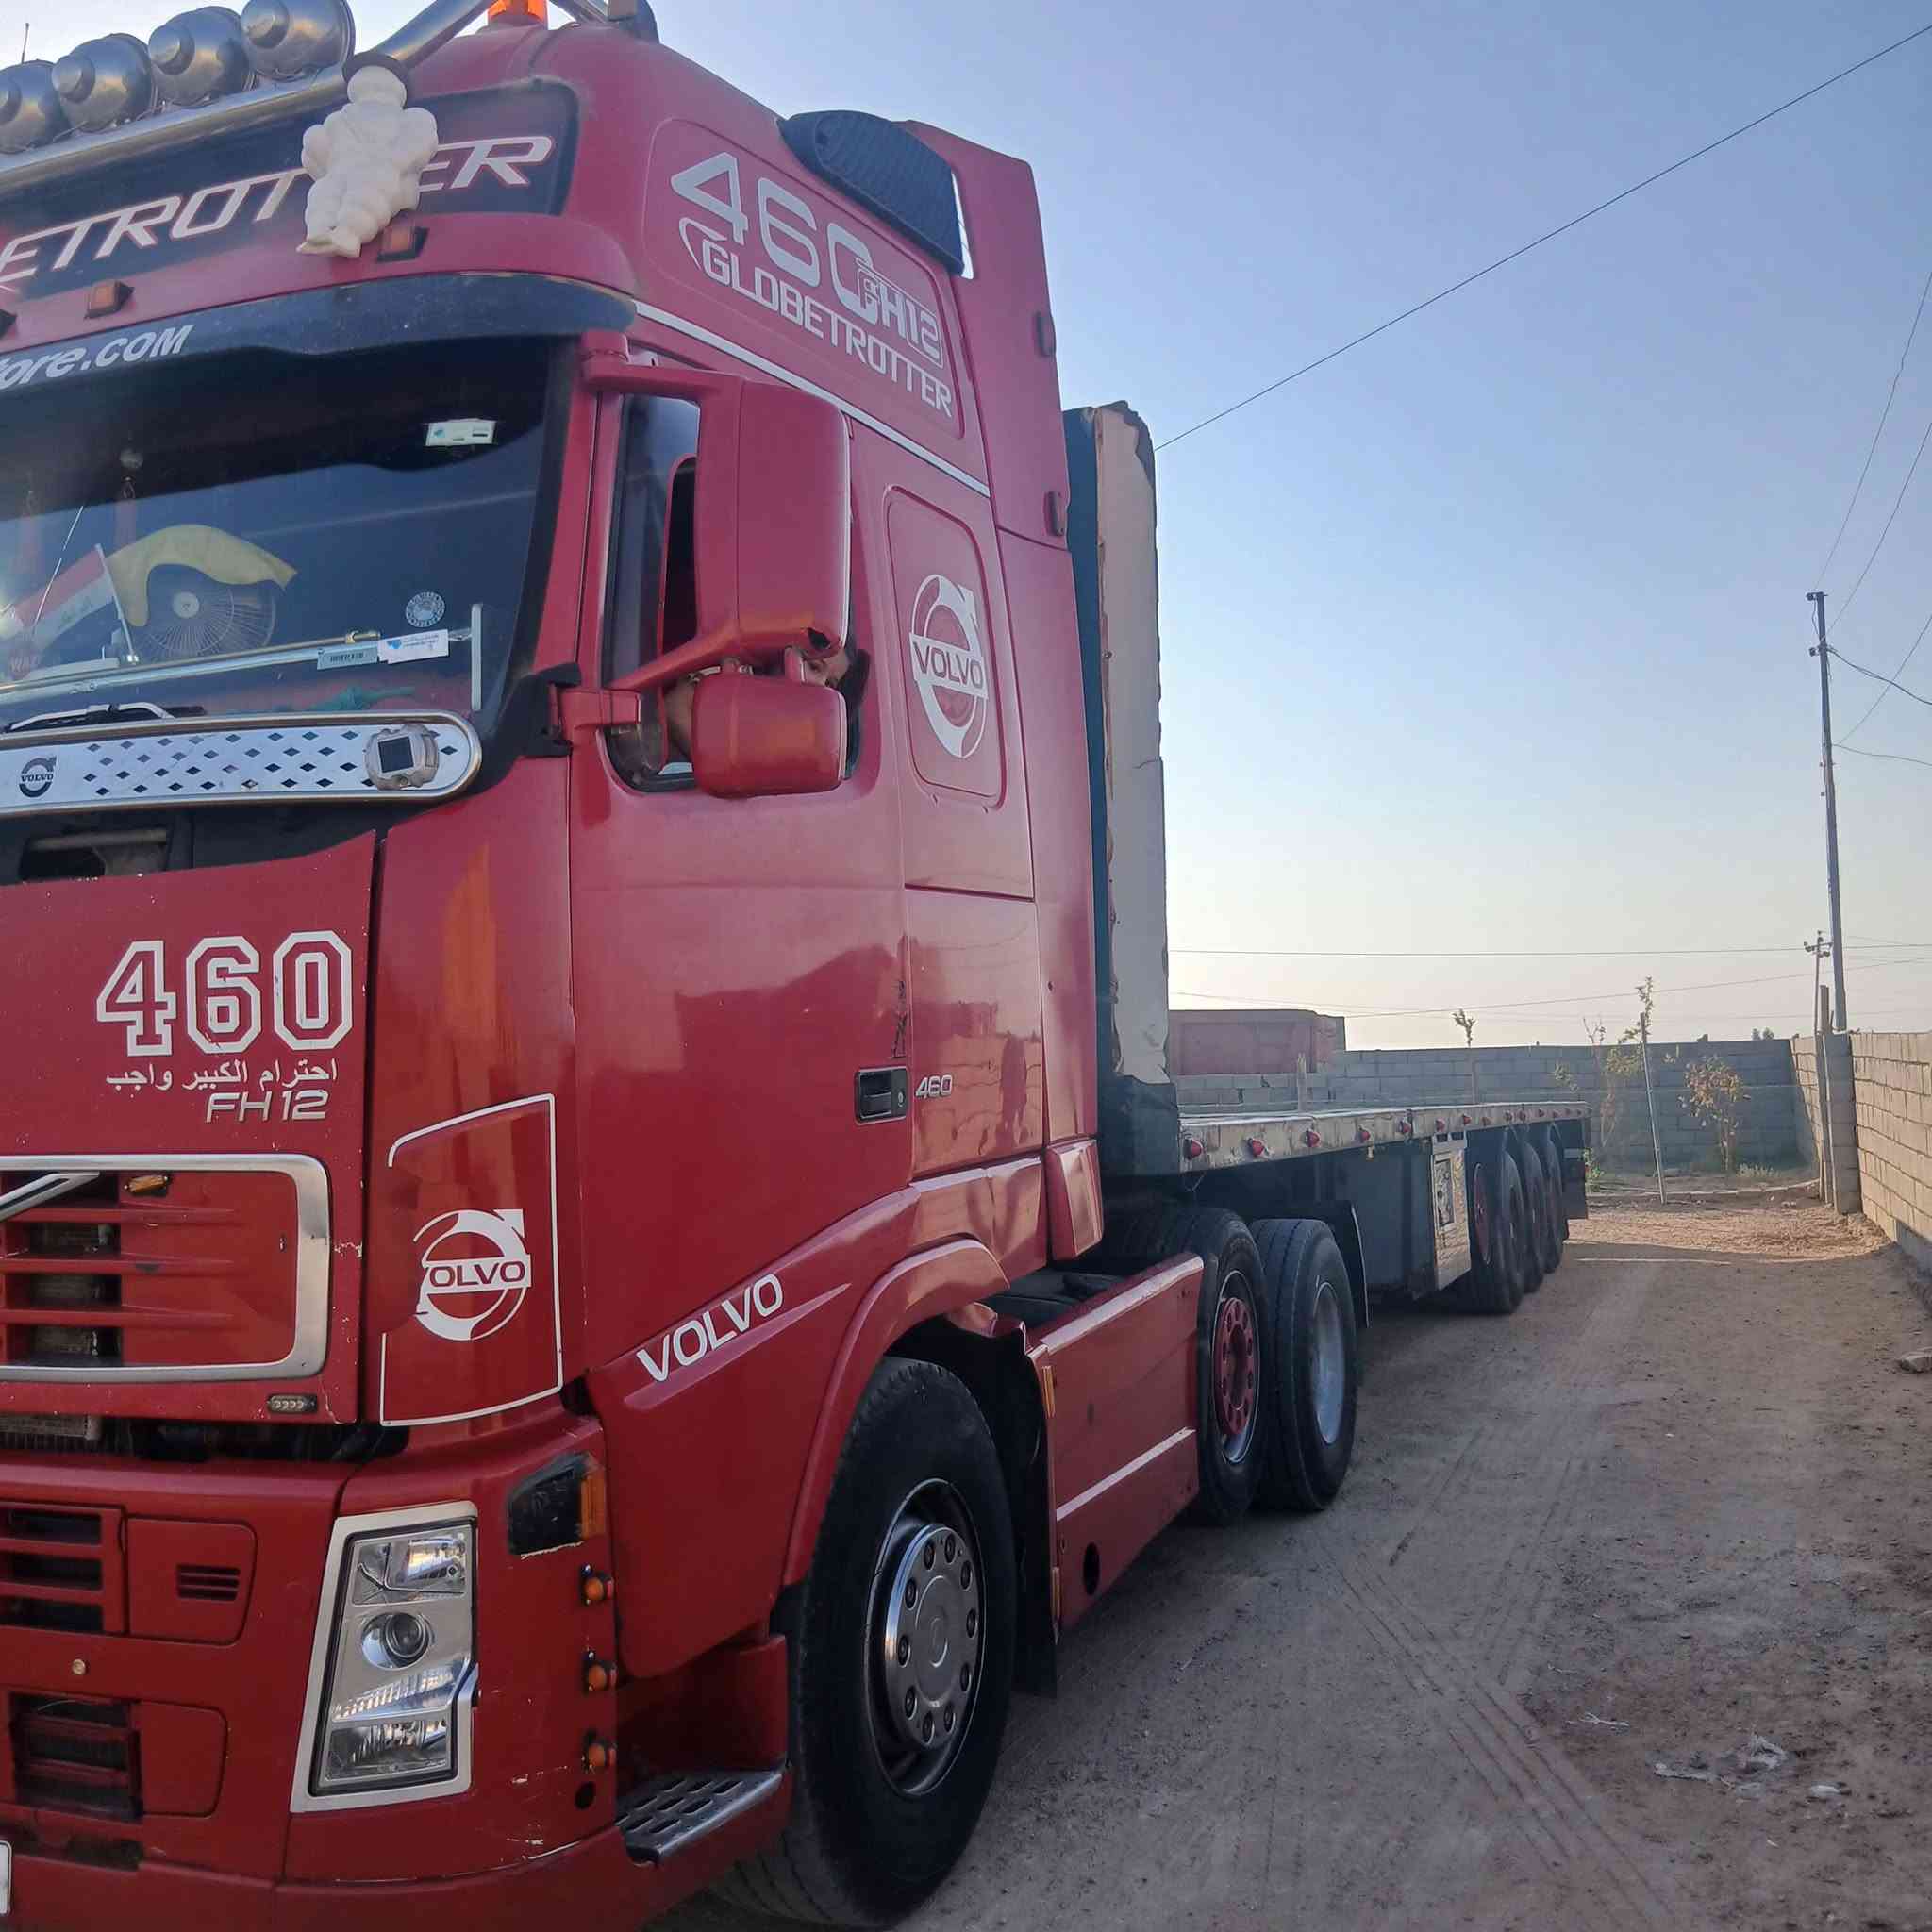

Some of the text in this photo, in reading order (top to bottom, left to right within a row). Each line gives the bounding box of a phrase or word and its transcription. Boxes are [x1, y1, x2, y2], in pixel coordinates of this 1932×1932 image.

[0, 136, 554, 282] ETROTER
[671, 152, 879, 325] 460
[702, 237, 953, 417] GLOBETROTTER
[913, 641, 984, 690] VOLVO
[21, 773, 55, 783] VOLVO
[96, 930, 353, 1057] 460
[106, 1058, 338, 1091] احترام الكبير واجب
[915, 1074, 953, 1100] 460
[426, 1260, 526, 1288] OLVO
[636, 1274, 783, 1382] VOLVO
